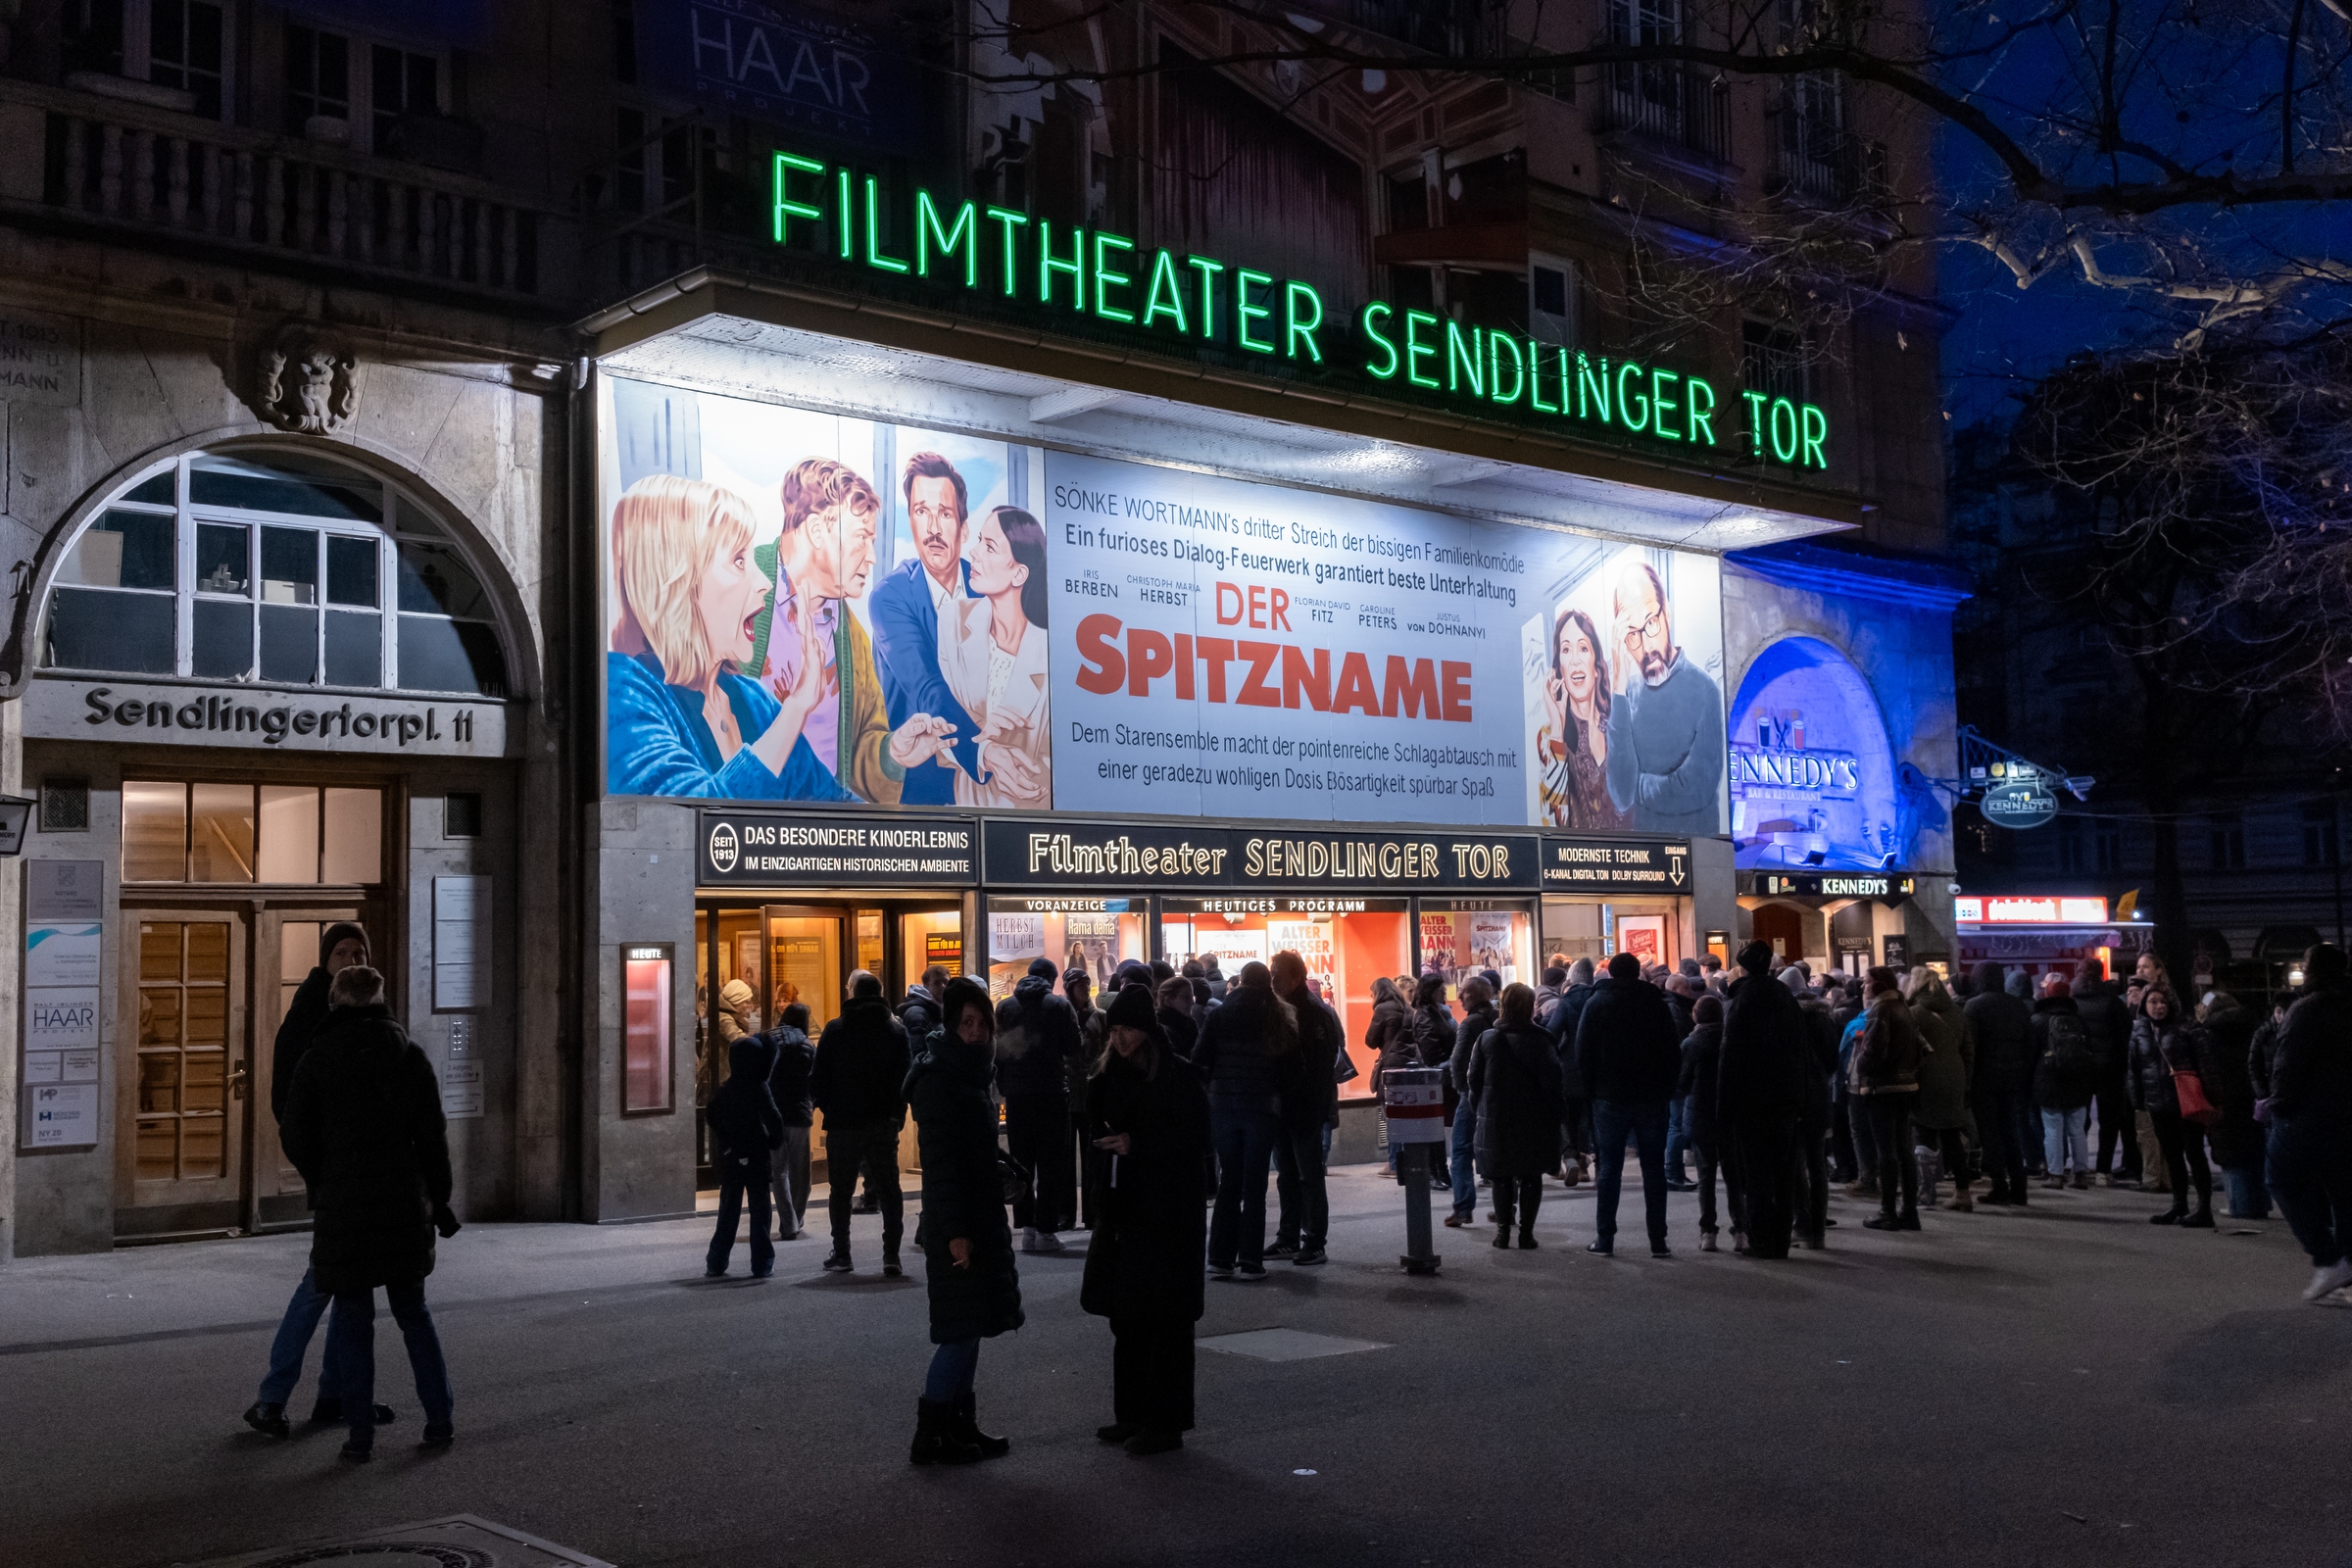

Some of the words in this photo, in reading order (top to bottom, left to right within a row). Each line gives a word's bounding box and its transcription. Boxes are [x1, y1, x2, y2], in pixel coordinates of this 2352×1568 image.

[691, 8, 870, 116] HAAR
[772, 150, 1324, 365] FILMTHEATER
[1362, 300, 1716, 446] SENDLINGER
[1742, 390, 1828, 469] TOR
[1054, 481, 1118, 516] SÖNKE
[1124, 497, 1240, 534] WORTMANN's
[1244, 513, 1286, 542] dritter
[1291, 522, 1338, 549] Streich
[1342, 532, 1364, 553] der
[1367, 534, 1422, 563] bissigen
[1065, 523, 1095, 548] Ein
[1099, 527, 1168, 559] furioses
[1173, 538, 1310, 577] Dialog-Feuerwerk
[1314, 563, 1385, 585] garantiert
[1388, 569, 1426, 590] beste
[1430, 572, 1516, 608] Unterhaltung
[1083, 569, 1100, 580] IRIS
[1065, 578, 1118, 598] BERBEN
[1126, 574, 1173, 589] CHRISTOPH
[1175, 581, 1201, 593] MARIA
[1140, 588, 1188, 607] HERBST
[1294, 597, 1326, 608] FLORIAN
[1328, 601, 1351, 611] DAVID
[1215, 581, 1292, 633] DER
[1359, 604, 1396, 615] CAROLINE
[1311, 610, 1333, 623] FITZ
[1358, 613, 1398, 630] PETERS
[1437, 612, 1461, 623] JUSTUS
[1428, 622, 1487, 640] DOHNANYI
[1075, 612, 1473, 723] SPITZNAME
[84, 688, 441, 747] Sendlingertorpl.
[452, 709, 473, 743] 11
[1071, 722, 1109, 744] Dem
[1115, 723, 1218, 752] Starensemble
[1223, 734, 1270, 755] macht
[1273, 736, 1296, 757] der
[1299, 739, 1390, 762] pointenreiche
[1394, 742, 1494, 768] Schlagabtausch
[1497, 747, 1518, 768] mit
[1729, 750, 1858, 790] ENNEDY'S
[1098, 759, 1138, 780] einer
[1143, 763, 1212, 786] geradezu
[1216, 766, 1281, 791] wohligen
[1285, 767, 1324, 790] Dosis
[1327, 770, 1405, 798] Bösartigkeit
[1409, 774, 1458, 798] spürbar
[1461, 776, 1494, 800] Spaß
[1747, 789, 1762, 799] BAR
[1774, 790, 1821, 803] RESTAURANT
[1988, 799, 2054, 812] KENNEDY'S
[714, 837, 734, 848] SEIT
[745, 826, 775, 844] DAS
[780, 828, 866, 847] BESONDERE
[870, 830, 968, 850] KINOERLEBNIS
[714, 850, 734, 860] 1913
[1028, 833, 1227, 875] Filmtheater
[1244, 838, 1440, 879] SENDLINGER
[1450, 844, 1510, 879] TOR
[1558, 847, 1611, 862] MODERNSTE
[1614, 850, 1649, 863] TECHNIK
[1665, 847, 1687, 857] EINGANG
[745, 857, 759, 870] IM
[761, 858, 842, 871] EINZIGARTIGEN
[843, 858, 918, 873] HISTORISCHEN
[919, 859, 969, 873] AMBIENTE
[1612, 870, 1632, 881] DOLBY
[1633, 870, 1665, 881] SURROUND
[1822, 878, 1886, 894] KENNEDY'S
[1027, 900, 1106, 912] VORANZEIGE
[1203, 900, 1277, 912] HEUTIGES
[1290, 900, 1365, 912] PROGRAMM
[1451, 901, 1494, 911] HEUTE
[997, 917, 1035, 933] HERBST
[1068, 918, 1092, 936] Rama
[1093, 919, 1116, 936] dama
[1421, 915, 1447, 926] ALTER
[1280, 926, 1318, 941] ALTER
[996, 934, 1034, 950] MILCH
[1270, 940, 1330, 955] WEISSER
[1838, 937, 1873, 948] KENNEDY'S
[632, 949, 662, 959] HEUTE
[33, 1008, 93, 1027] HAAR
